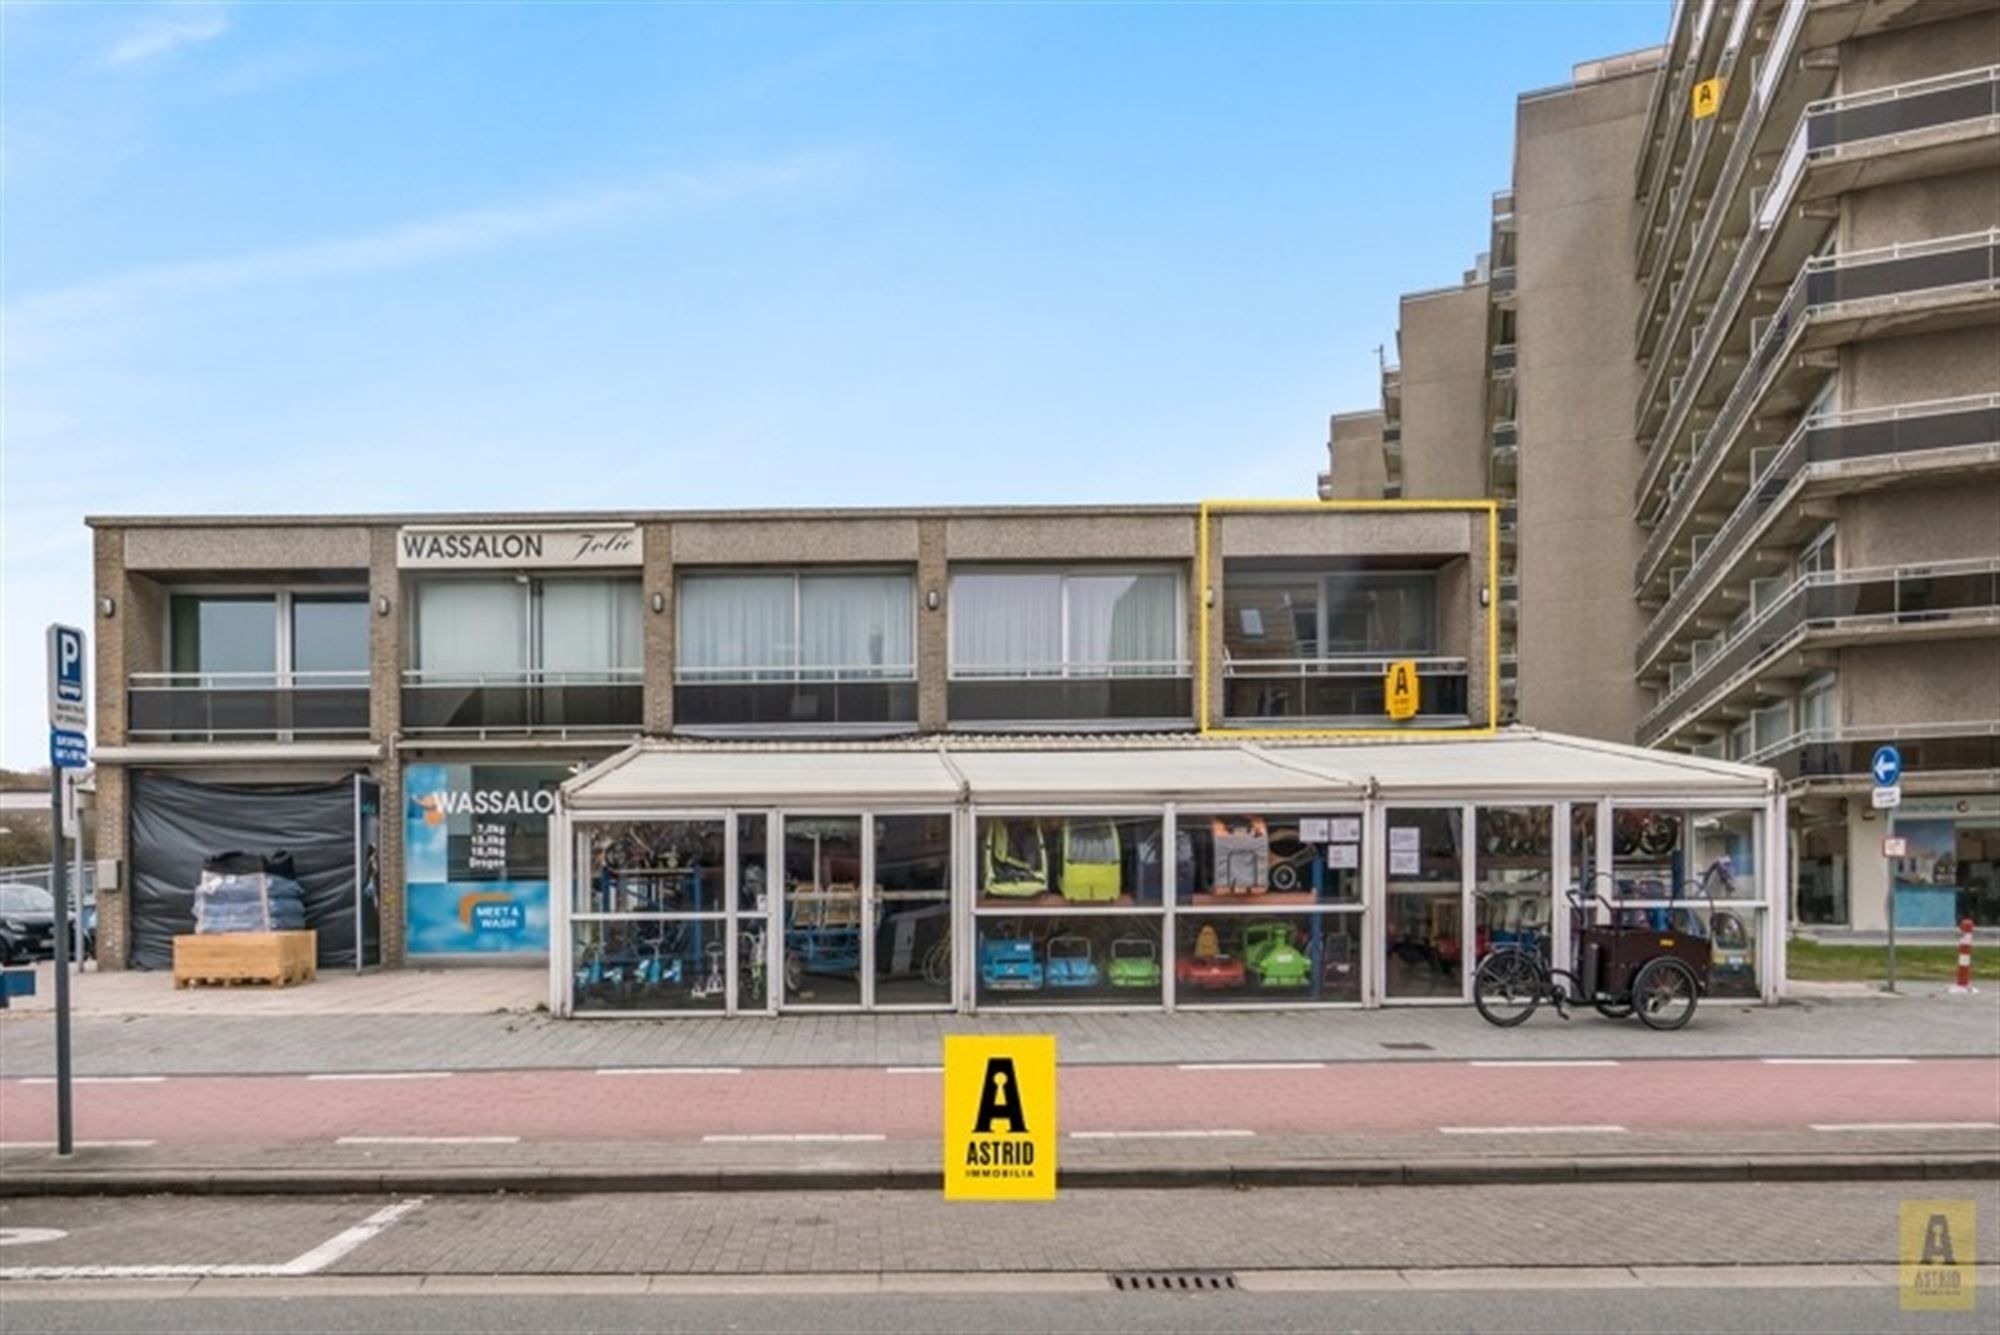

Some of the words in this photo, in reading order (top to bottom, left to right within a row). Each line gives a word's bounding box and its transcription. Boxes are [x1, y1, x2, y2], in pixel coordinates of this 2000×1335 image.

[403, 534, 543, 559] WASSALON
[573, 531, 634, 561] Jolie
[61, 632, 79, 677] P
[1395, 667, 1409, 695] A
[475, 906, 509, 917] MEET
[481, 917, 517, 929] WASH
